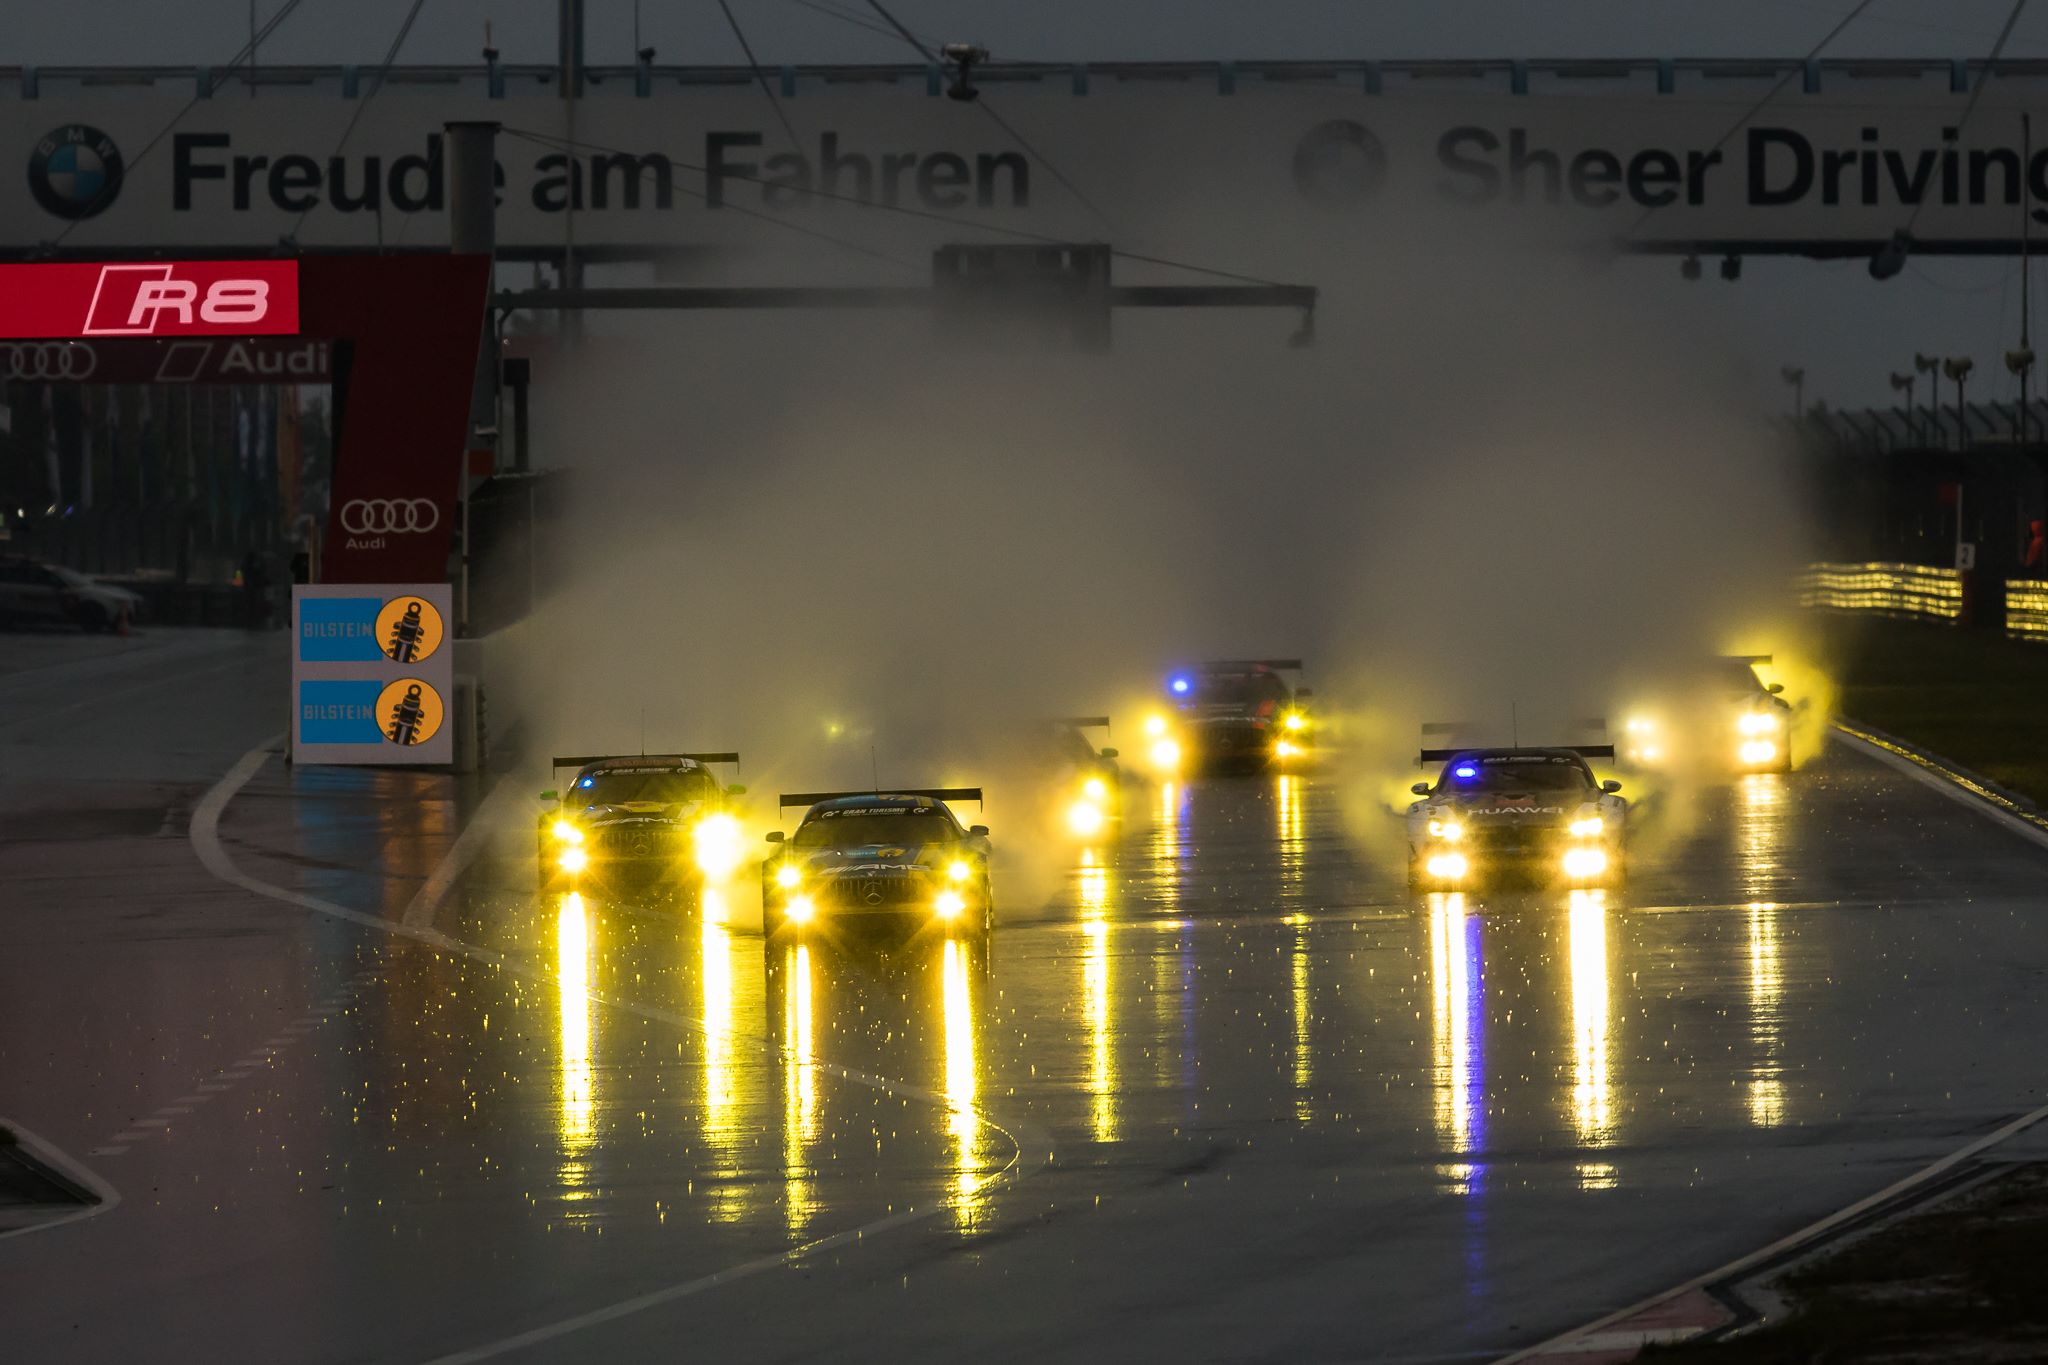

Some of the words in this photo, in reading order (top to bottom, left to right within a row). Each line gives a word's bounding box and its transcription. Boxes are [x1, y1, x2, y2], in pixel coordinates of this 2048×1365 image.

[173, 132, 505, 212] Freud
[532, 152, 673, 212] am
[706, 131, 1030, 208] Fahren
[1436, 126, 1723, 206] Sheer
[127, 279, 270, 324] R8
[219, 342, 328, 375] Audi
[345, 537, 386, 550] Audi
[304, 622, 373, 638] BILSTEIN
[304, 704, 373, 720] BILSTEIN
[1467, 806, 1563, 816] HUAWEI
